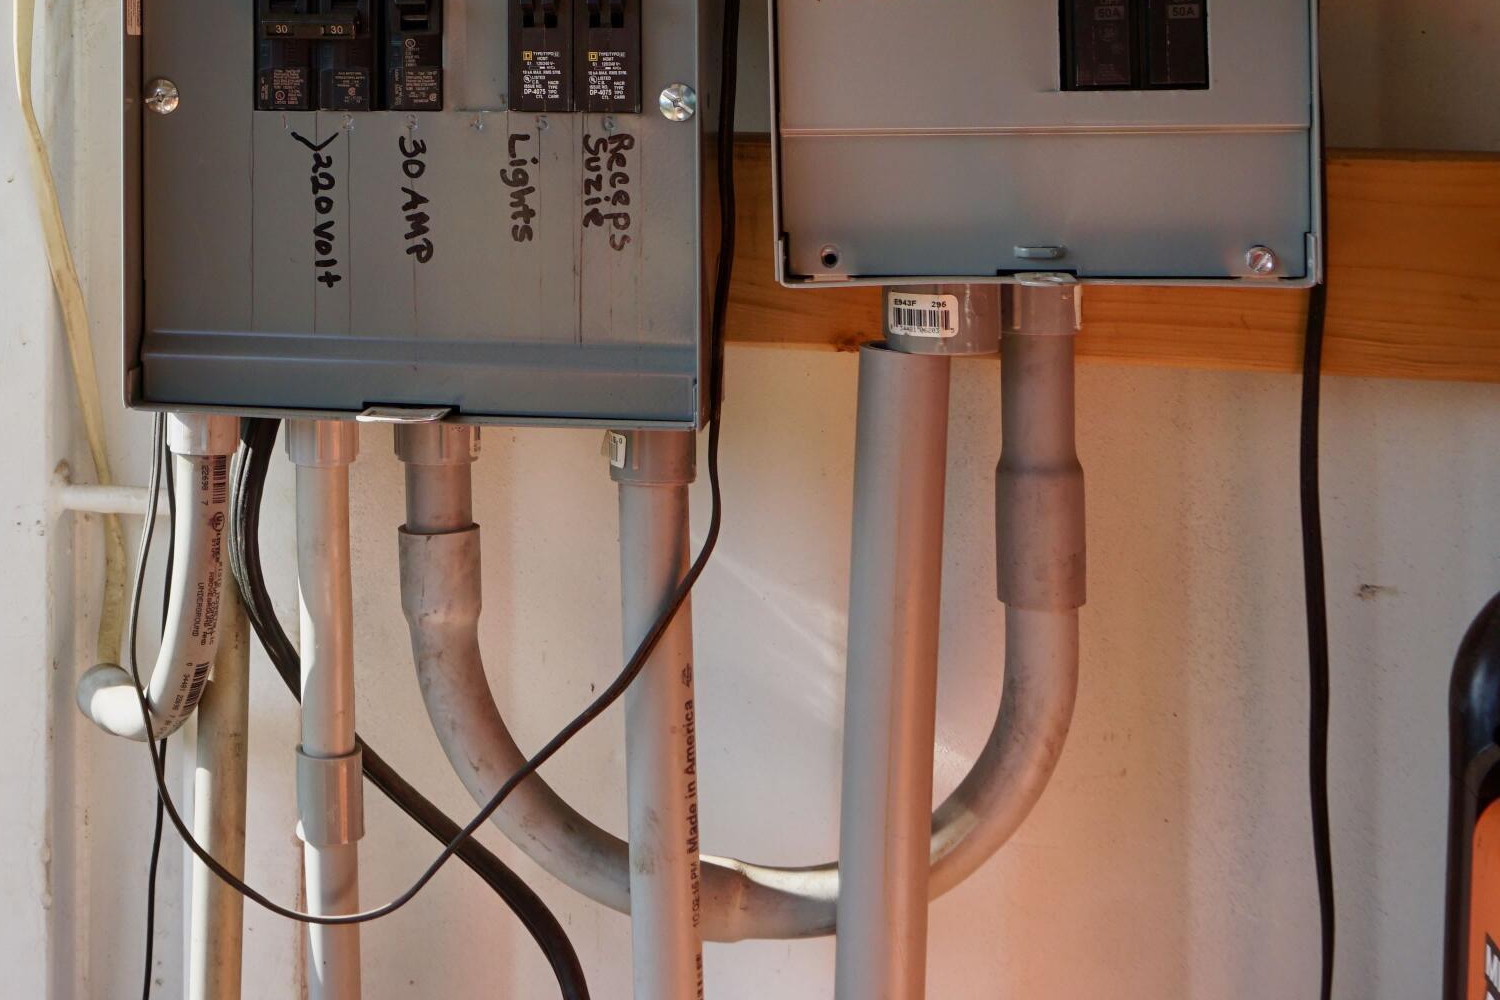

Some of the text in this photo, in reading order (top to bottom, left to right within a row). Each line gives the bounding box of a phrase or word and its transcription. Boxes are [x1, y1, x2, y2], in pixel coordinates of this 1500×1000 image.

[276, 25, 288, 34] 30
[330, 25, 343, 34] 30
[1172, 6, 1196, 17] 50A
[398, 136, 426, 178] 30
[310, 152, 336, 216] 220
[500, 134, 540, 244] Lights
[400, 187, 434, 264] AMP
[192, 582, 204, 637] UNDERGROUND
[682, 700, 696, 776] America
[685, 781, 697, 800] in
[686, 803, 699, 854] Made
